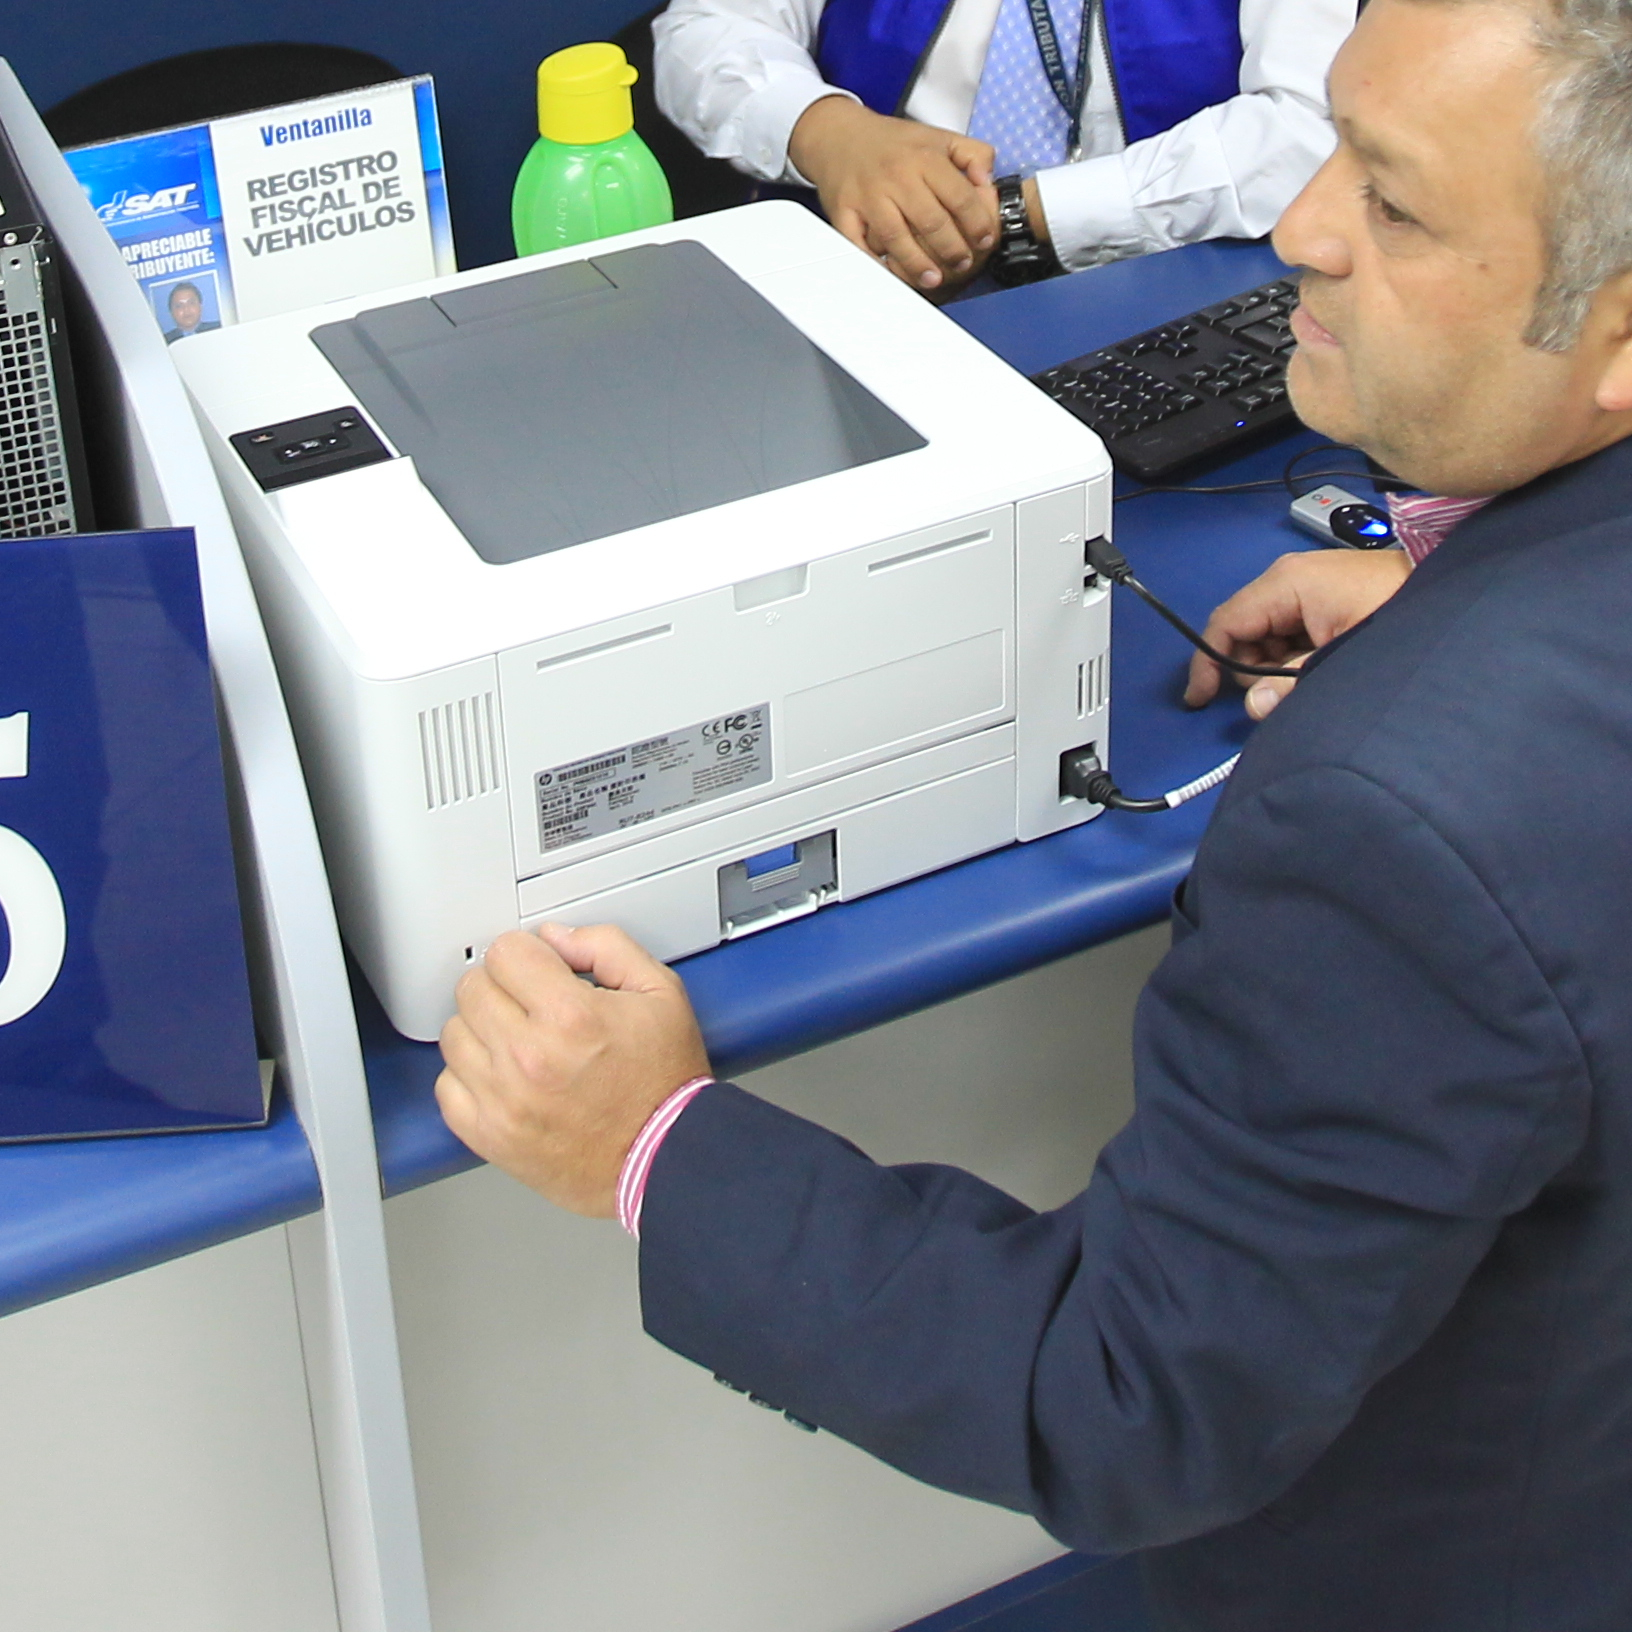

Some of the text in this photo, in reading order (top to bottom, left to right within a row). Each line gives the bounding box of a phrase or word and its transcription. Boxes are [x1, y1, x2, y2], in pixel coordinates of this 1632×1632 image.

[259, 107, 373, 147] Ventanilla
[246, 150, 398, 202] REGISTRO
[122, 182, 197, 216] SAT
[250, 176, 403, 229] FISCAL DE
[121, 228, 213, 263] APRECIABLE
[243, 201, 416, 257] VEHÍCULOS
[130, 248, 215, 280] RIBUYENTE:
